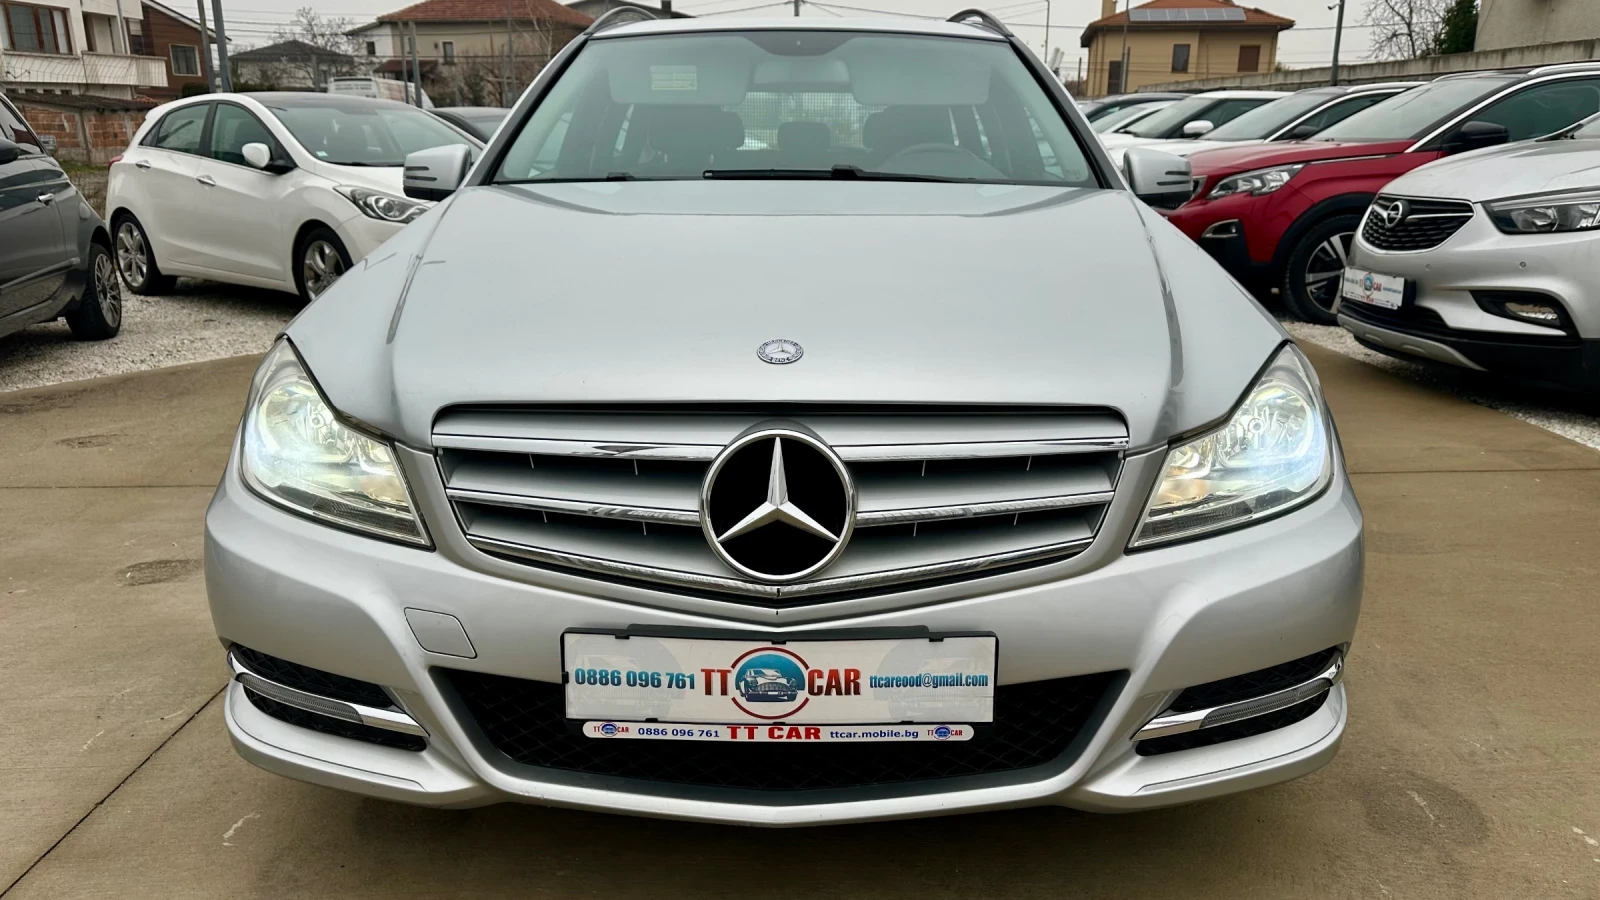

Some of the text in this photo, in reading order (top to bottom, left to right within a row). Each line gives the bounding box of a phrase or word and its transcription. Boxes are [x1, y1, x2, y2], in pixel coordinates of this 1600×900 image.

[575, 668, 988, 696] 0886 096 761 TT CAR ttcareood@gmail.com
[638, 727, 668, 736] 0886
[672, 728, 694, 737] 096
[698, 729, 719, 738] 761
[727, 726, 758, 740] TT
[768, 726, 821, 740] CAR
[830, 729, 919, 739] ttcar.mobile.bg
